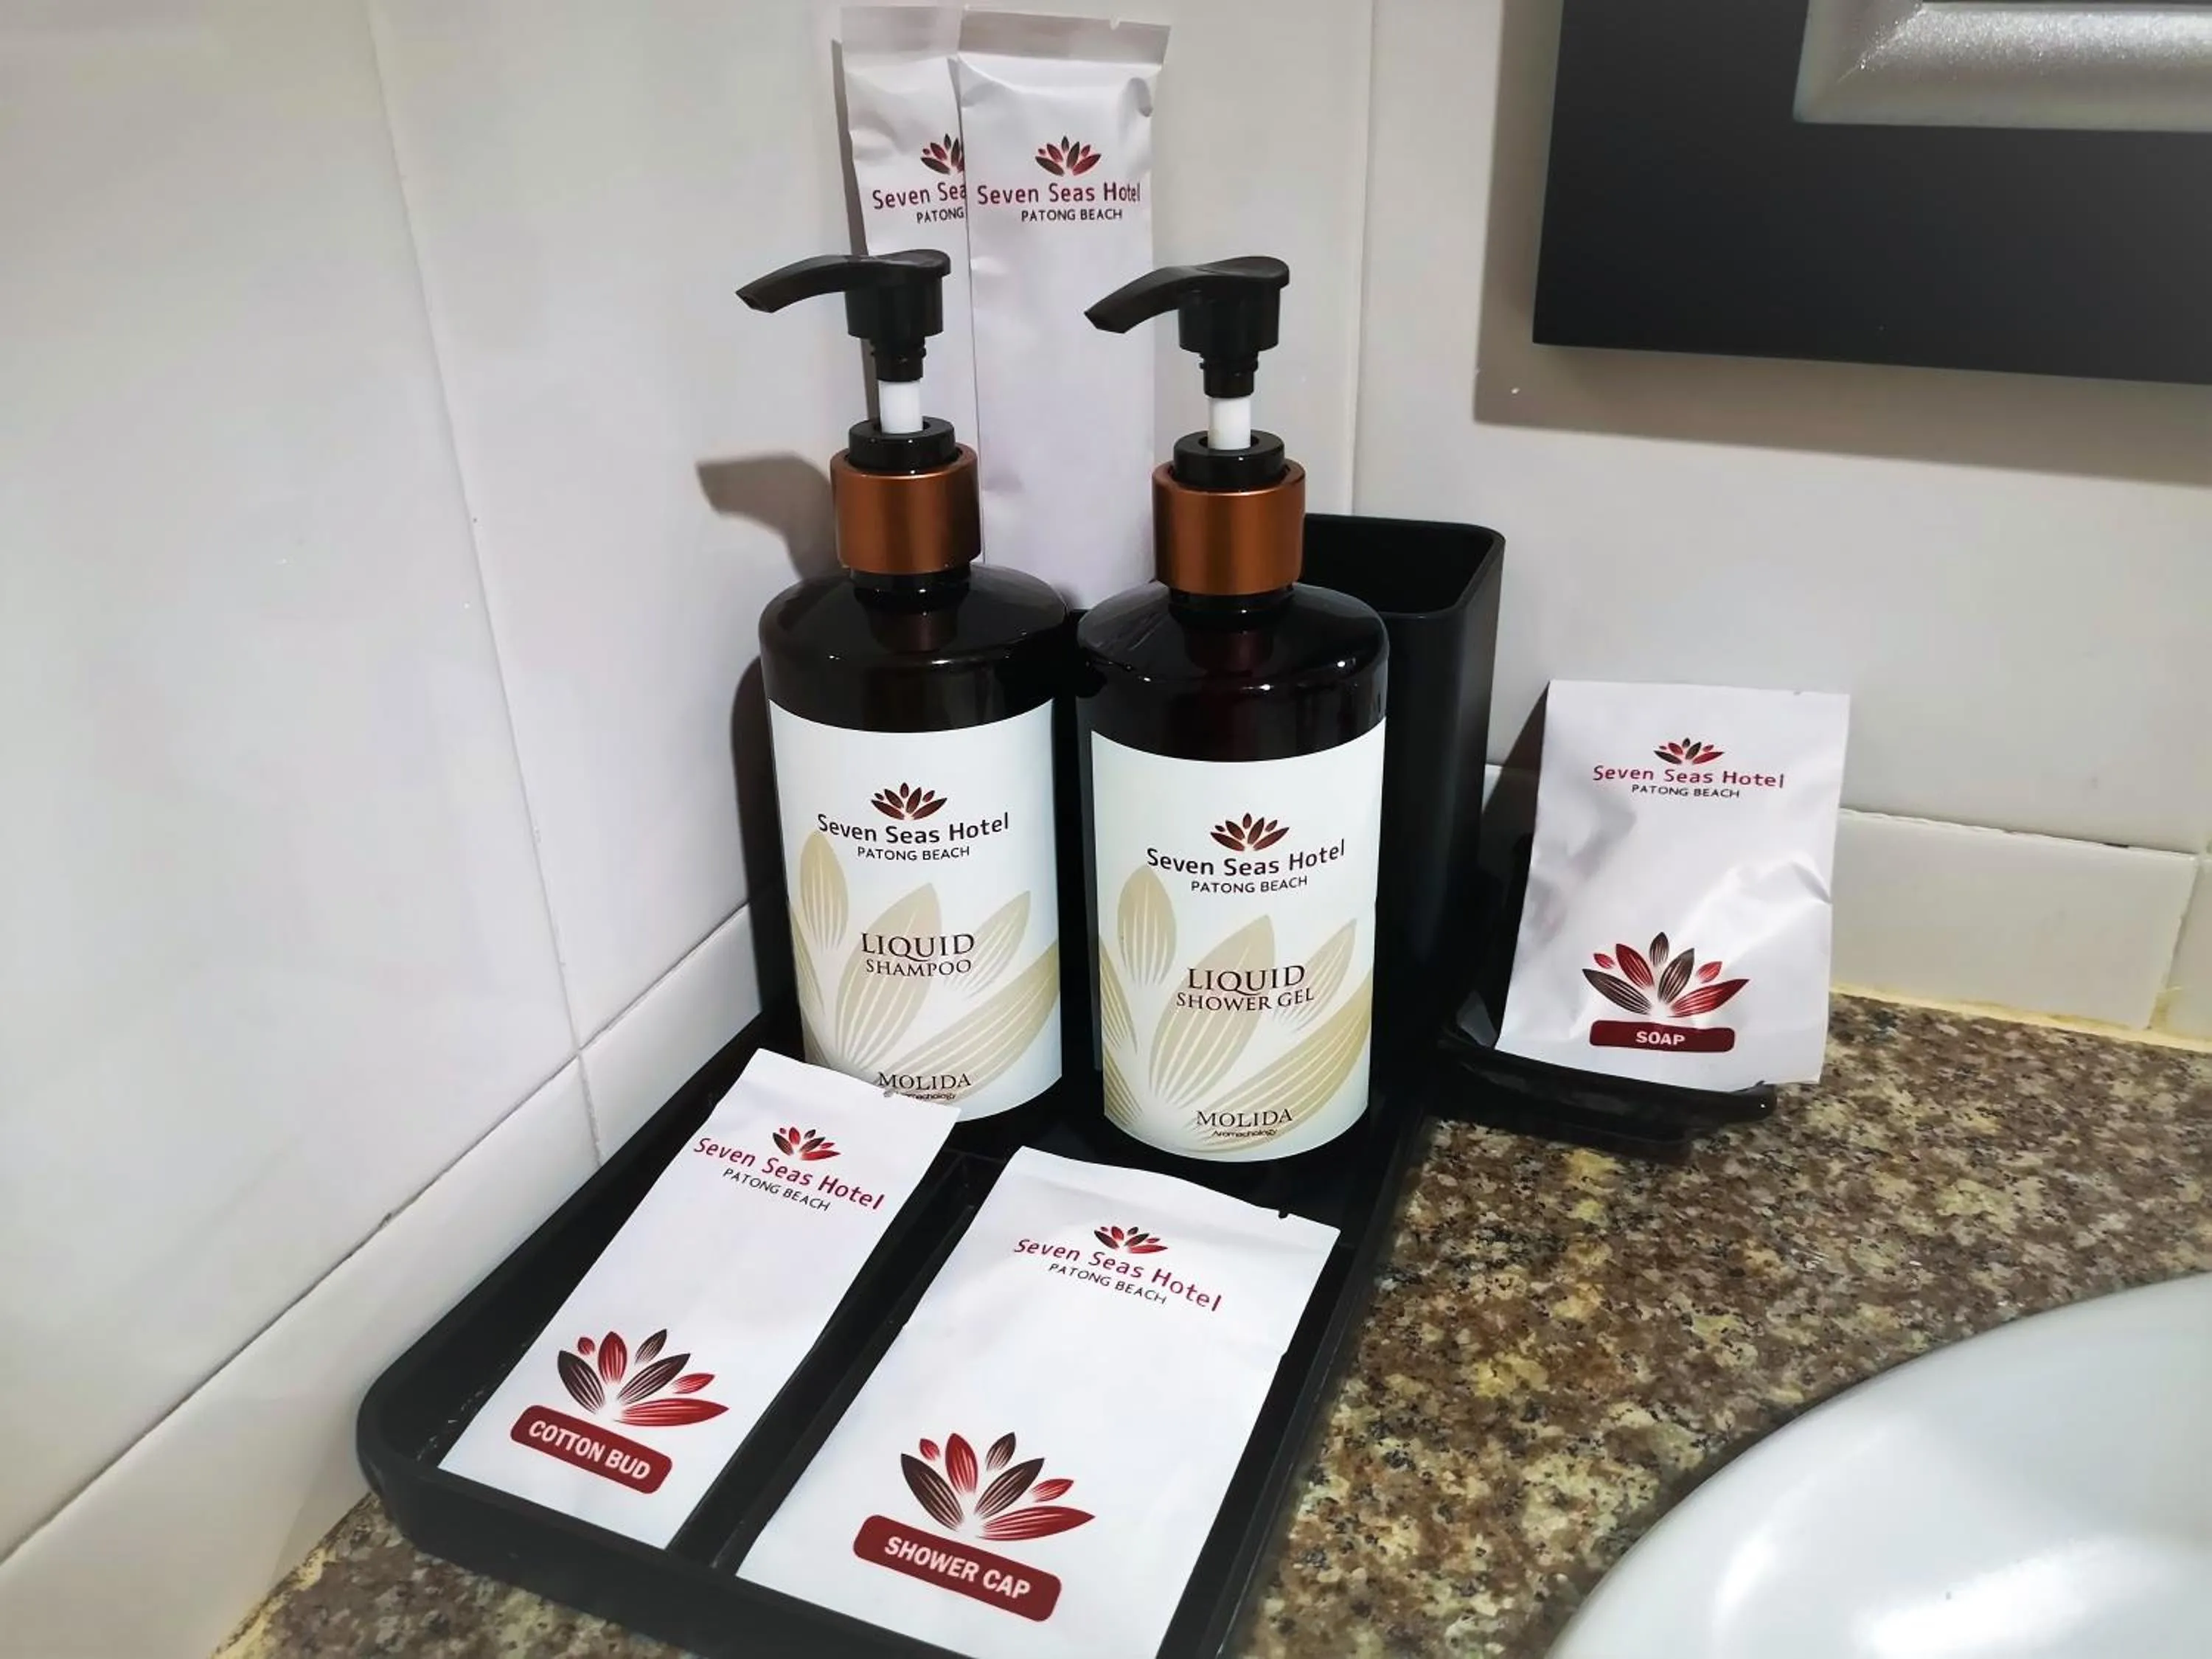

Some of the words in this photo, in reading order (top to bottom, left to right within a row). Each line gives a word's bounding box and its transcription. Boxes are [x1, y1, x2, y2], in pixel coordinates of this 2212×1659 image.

[872, 187, 930, 209] Seven
[937, 181, 966, 201] Sea
[977, 185, 1039, 205] Seven
[1048, 183, 1095, 203] Seas
[1104, 181, 1141, 202] Hotel
[917, 206, 964, 223] PATONG
[1021, 210, 1076, 222] PATONG
[1080, 209, 1122, 220] BEACH
[1593, 765, 1654, 782] Seven
[1664, 768, 1714, 785] Seas
[1722, 771, 1784, 788] Hotel
[1632, 784, 1688, 797] PATONG
[1694, 787, 1740, 799] BEACH
[817, 813, 877, 842] Seven
[886, 826, 940, 844] Seas
[949, 812, 1009, 841] Hotel
[857, 846, 917, 861] PATONG
[922, 846, 970, 860] BEACH
[1147, 848, 1214, 875] Seven
[1223, 858, 1279, 877] Seas
[1289, 838, 1345, 871] Hotel
[1191, 880, 1254, 894] PATONG
[1260, 875, 1308, 892] BEACH
[860, 932, 975, 962] LIQUID
[866, 959, 972, 977] SHAMPOO
[1187, 964, 1305, 996] LIQUID
[1176, 992, 1272, 1011] SHOWER
[1277, 988, 1315, 1007] GEL
[1635, 1032, 1686, 1046] SOAP
[877, 1071, 972, 1090] MOLIDA
[1196, 1108, 1293, 1127] MOLIDA
[693, 1138, 756, 1167] Seven
[762, 1157, 813, 1186] Seas
[818, 1175, 885, 1210] Hotel
[723, 1167, 781, 1194] PATONG
[782, 1188, 831, 1211] BEACH
[1014, 1238, 1080, 1262] Seven
[1088, 1251, 1144, 1279] Seas
[1151, 1268, 1222, 1312] Hotel
[1048, 1263, 1110, 1287] PATONG
[1114, 1281, 1167, 1304] BEACH
[529, 1420, 606, 1462] COTTON
[605, 1449, 651, 1480] BUD
[885, 1536, 980, 1582] SHOWER
[983, 1569, 1031, 1599] CAP
